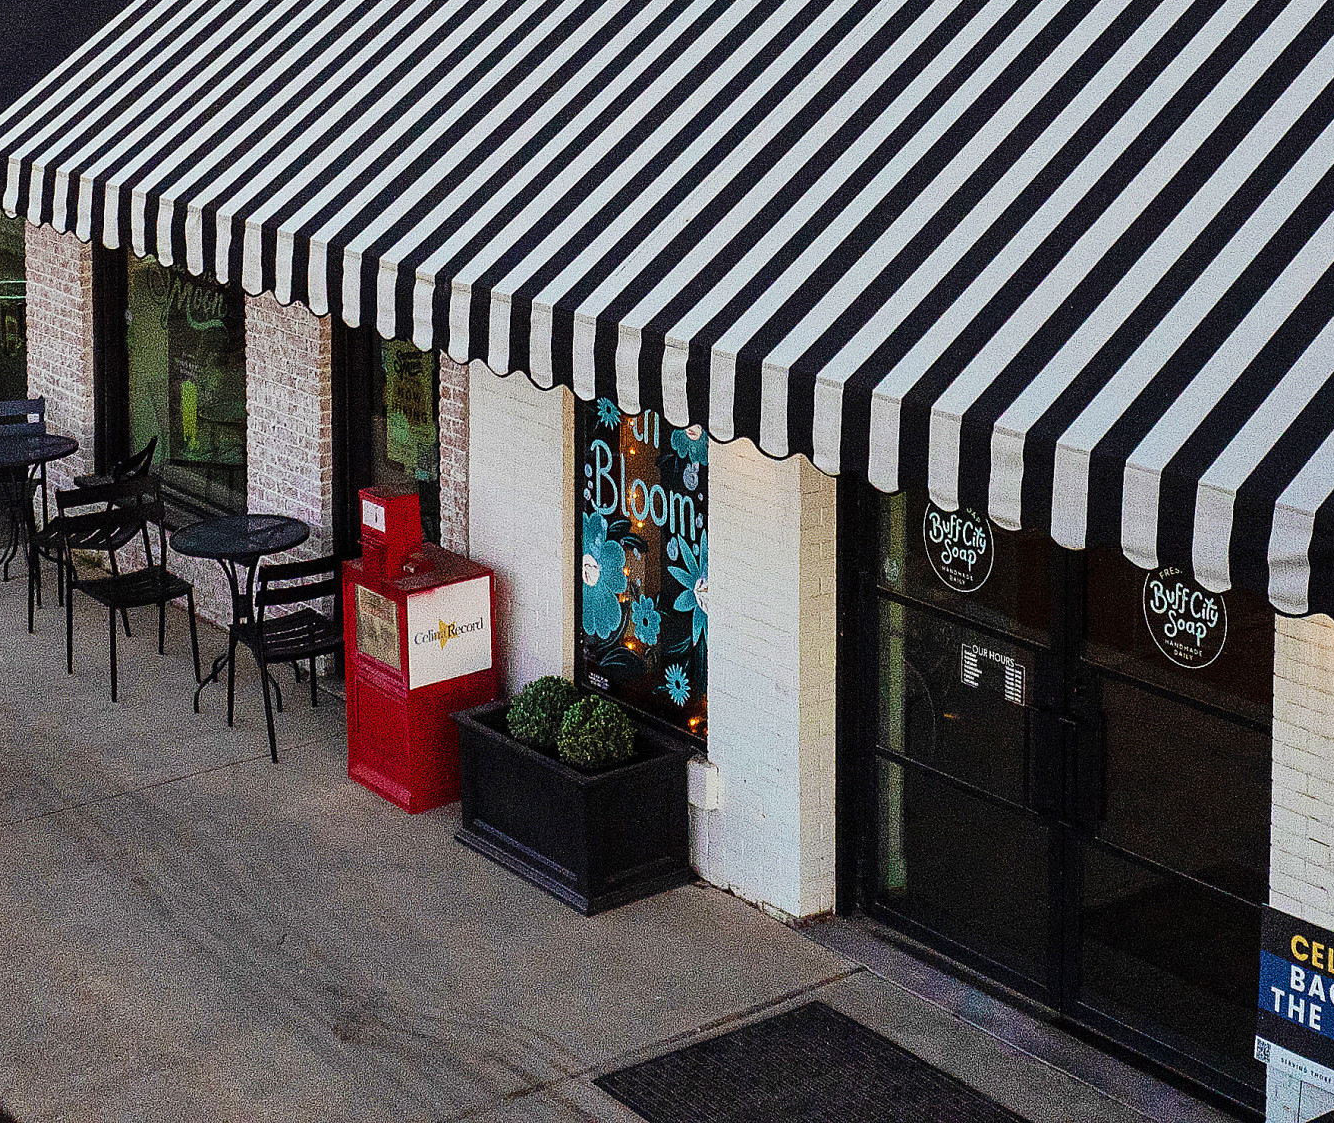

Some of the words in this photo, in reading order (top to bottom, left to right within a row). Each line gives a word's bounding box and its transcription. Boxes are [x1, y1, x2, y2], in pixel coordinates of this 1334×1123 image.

[589, 439, 696, 541] Bloom
[929, 512, 962, 543] Buff
[963, 521, 987, 554] City
[941, 538, 977, 572] Soap
[1159, 566, 1183, 580] FRES
[1150, 580, 1190, 614] Buff
[1190, 591, 1219, 628] City
[414, 629, 448, 645] Celina
[447, 617, 483, 638] Record
[1164, 609, 1207, 647] Soap
[972, 644, 988, 658] OUR
[989, 650, 1015, 668] HOURS
[1164, 639, 1203, 657] HANDMADE
[1173, 649, 1194, 661] DAILY
[1271, 986, 1322, 1031] THE
